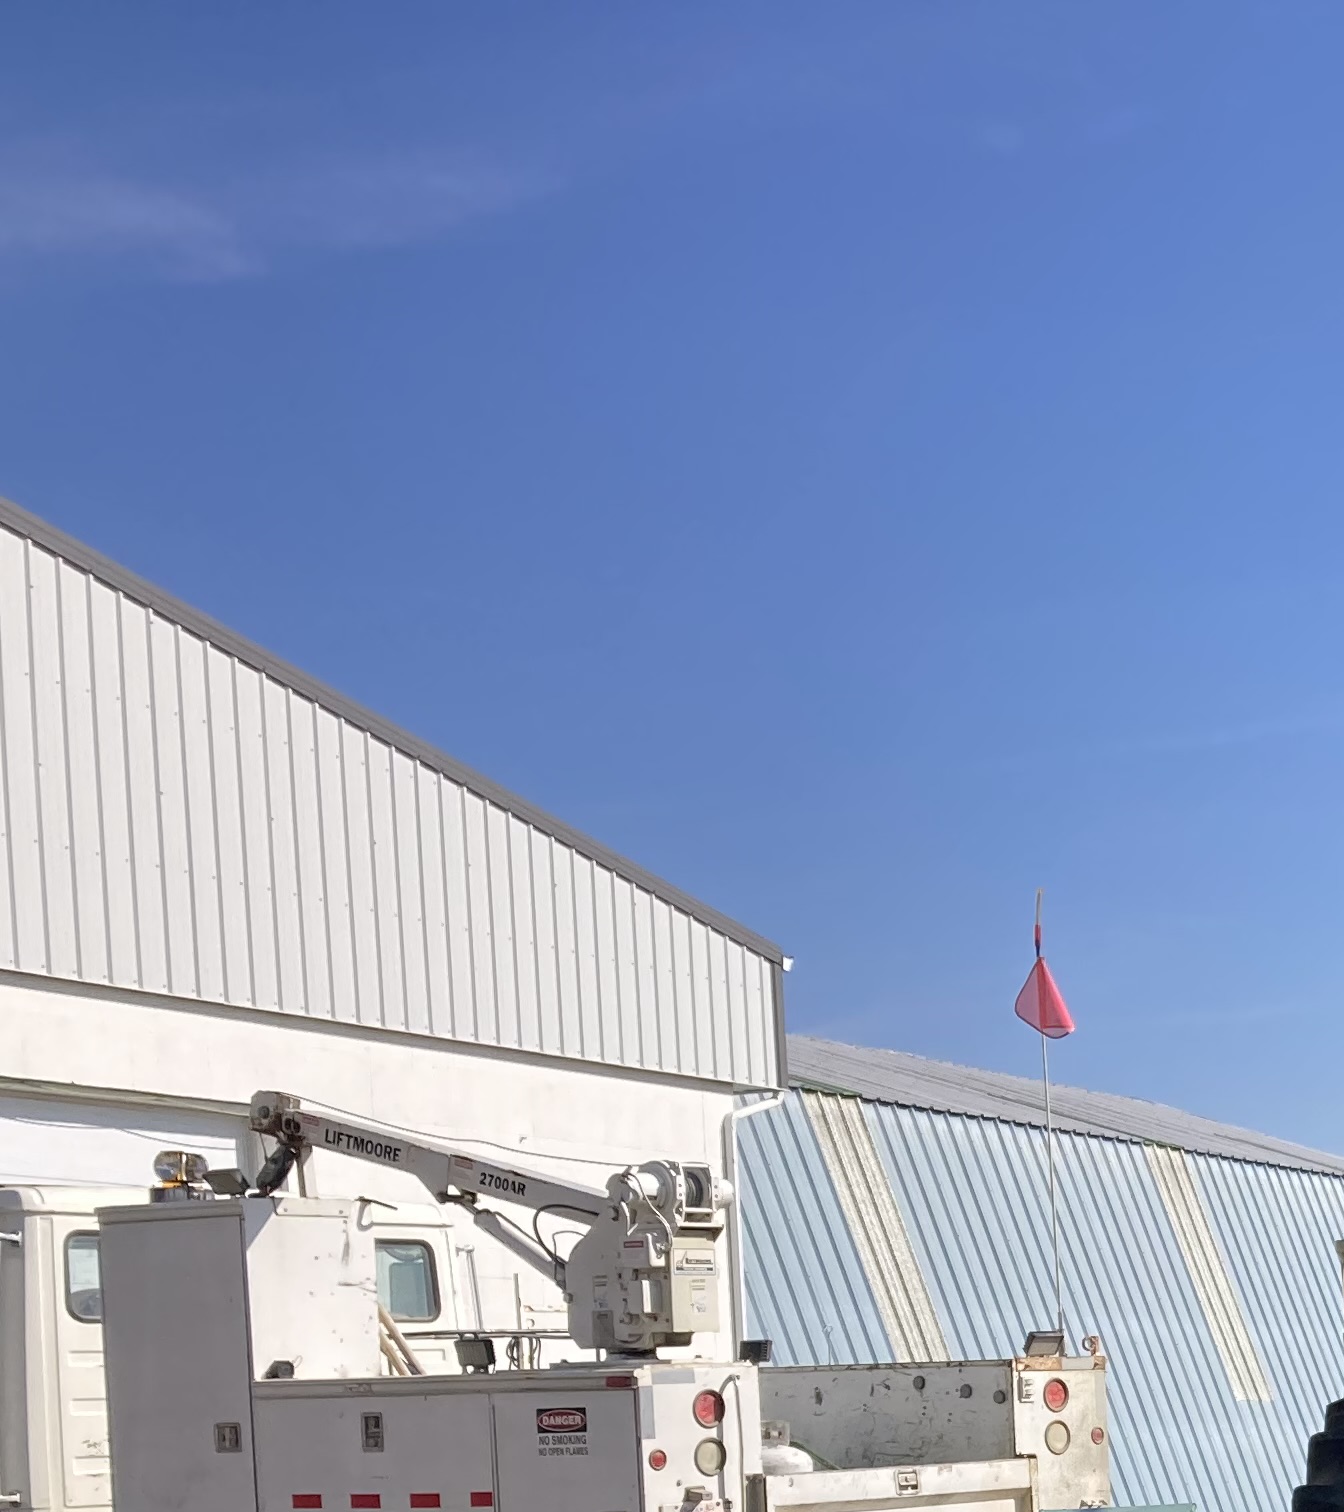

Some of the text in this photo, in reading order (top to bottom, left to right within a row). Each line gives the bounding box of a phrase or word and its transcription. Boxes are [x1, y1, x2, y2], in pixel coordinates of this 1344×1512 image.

[324, 1128, 402, 1163] LIFTMOORE
[478, 1171, 526, 1197] 2700AR
[542, 1415, 581, 1425] DANGER
[538, 1435, 587, 1446] NO SMOKING
[538, 1446, 588, 1457] NO OPEN FLAMES
